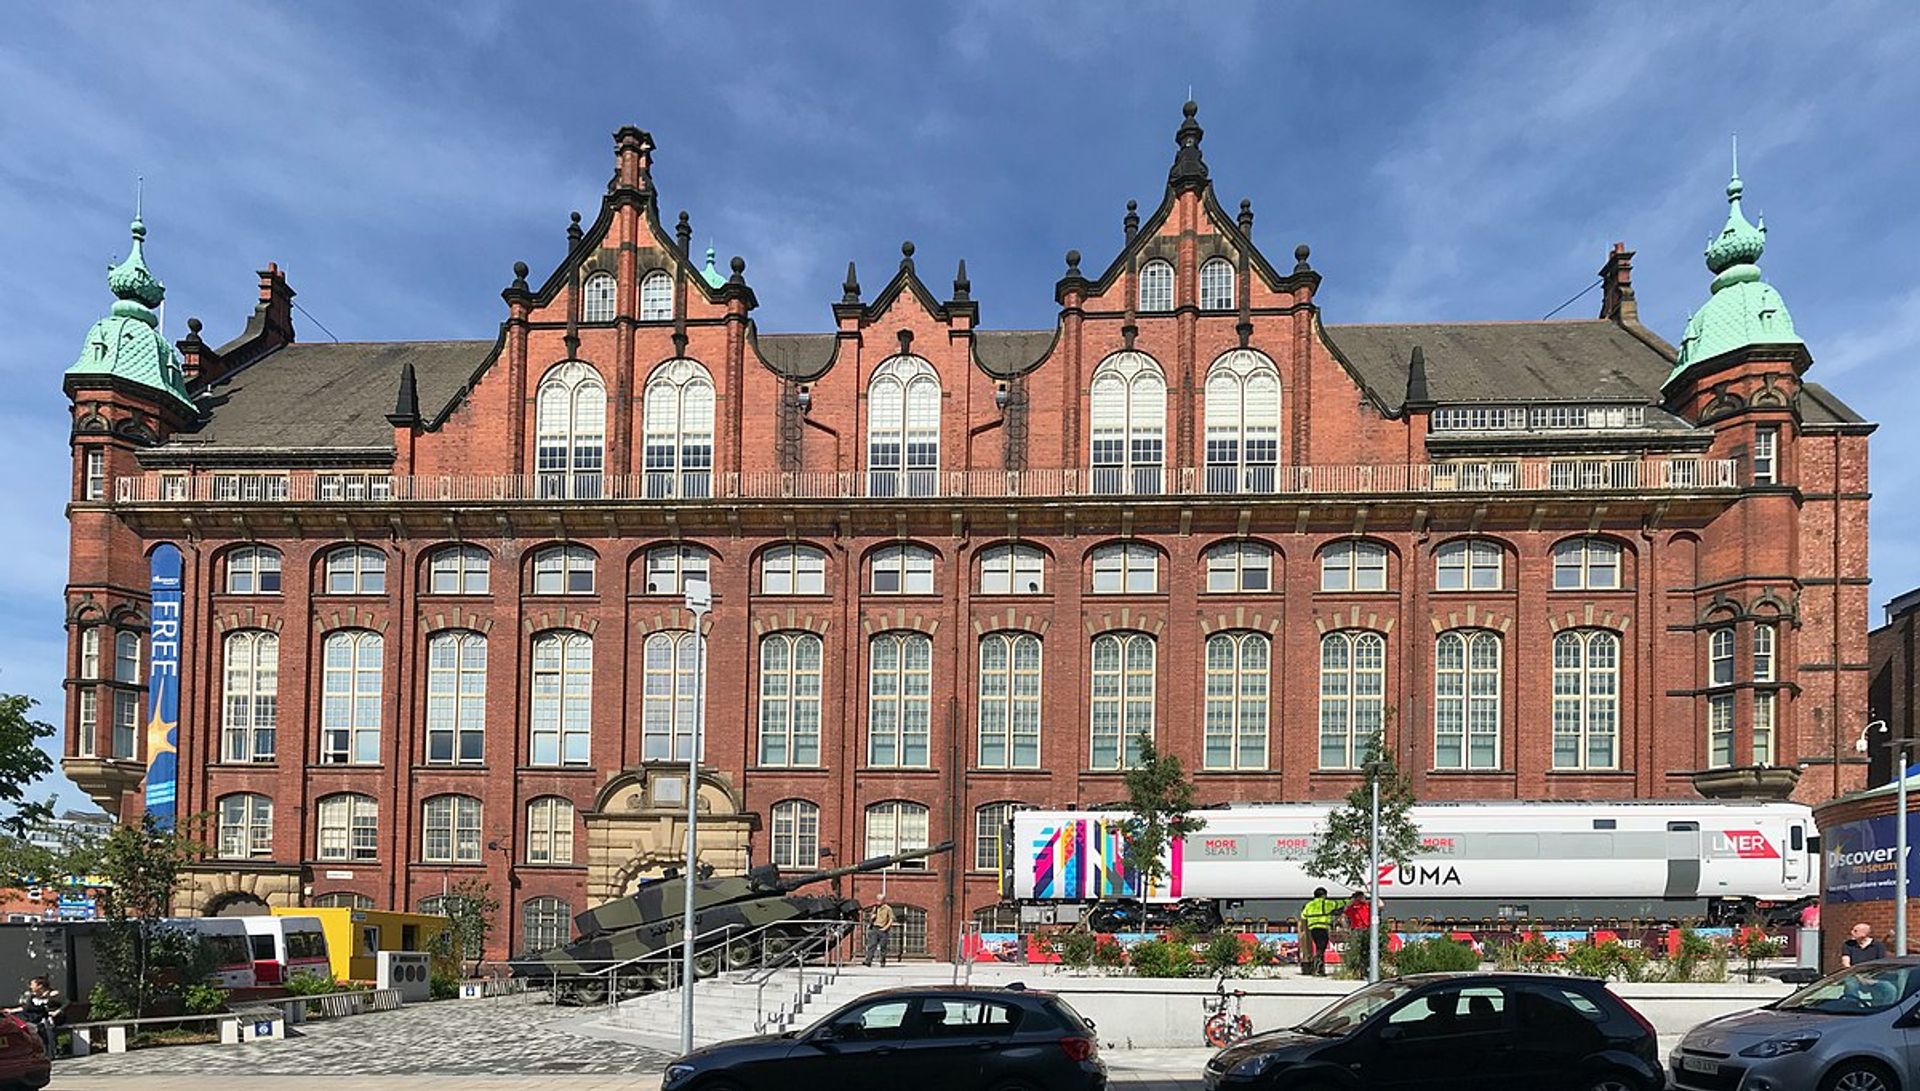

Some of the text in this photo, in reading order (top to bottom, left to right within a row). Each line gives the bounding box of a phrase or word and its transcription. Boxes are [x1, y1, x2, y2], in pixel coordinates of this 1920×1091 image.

[151, 601, 179, 676] FREE
[1205, 839, 1237, 848] MORE
[1276, 839, 1308, 847] MORE
[1423, 838, 1455, 846] MORE
[1712, 835, 1765, 851] LNER
[1204, 847, 1238, 856] SEATS
[1852, 862, 1897, 873] museum
[1367, 865, 1461, 885] ZUMA
